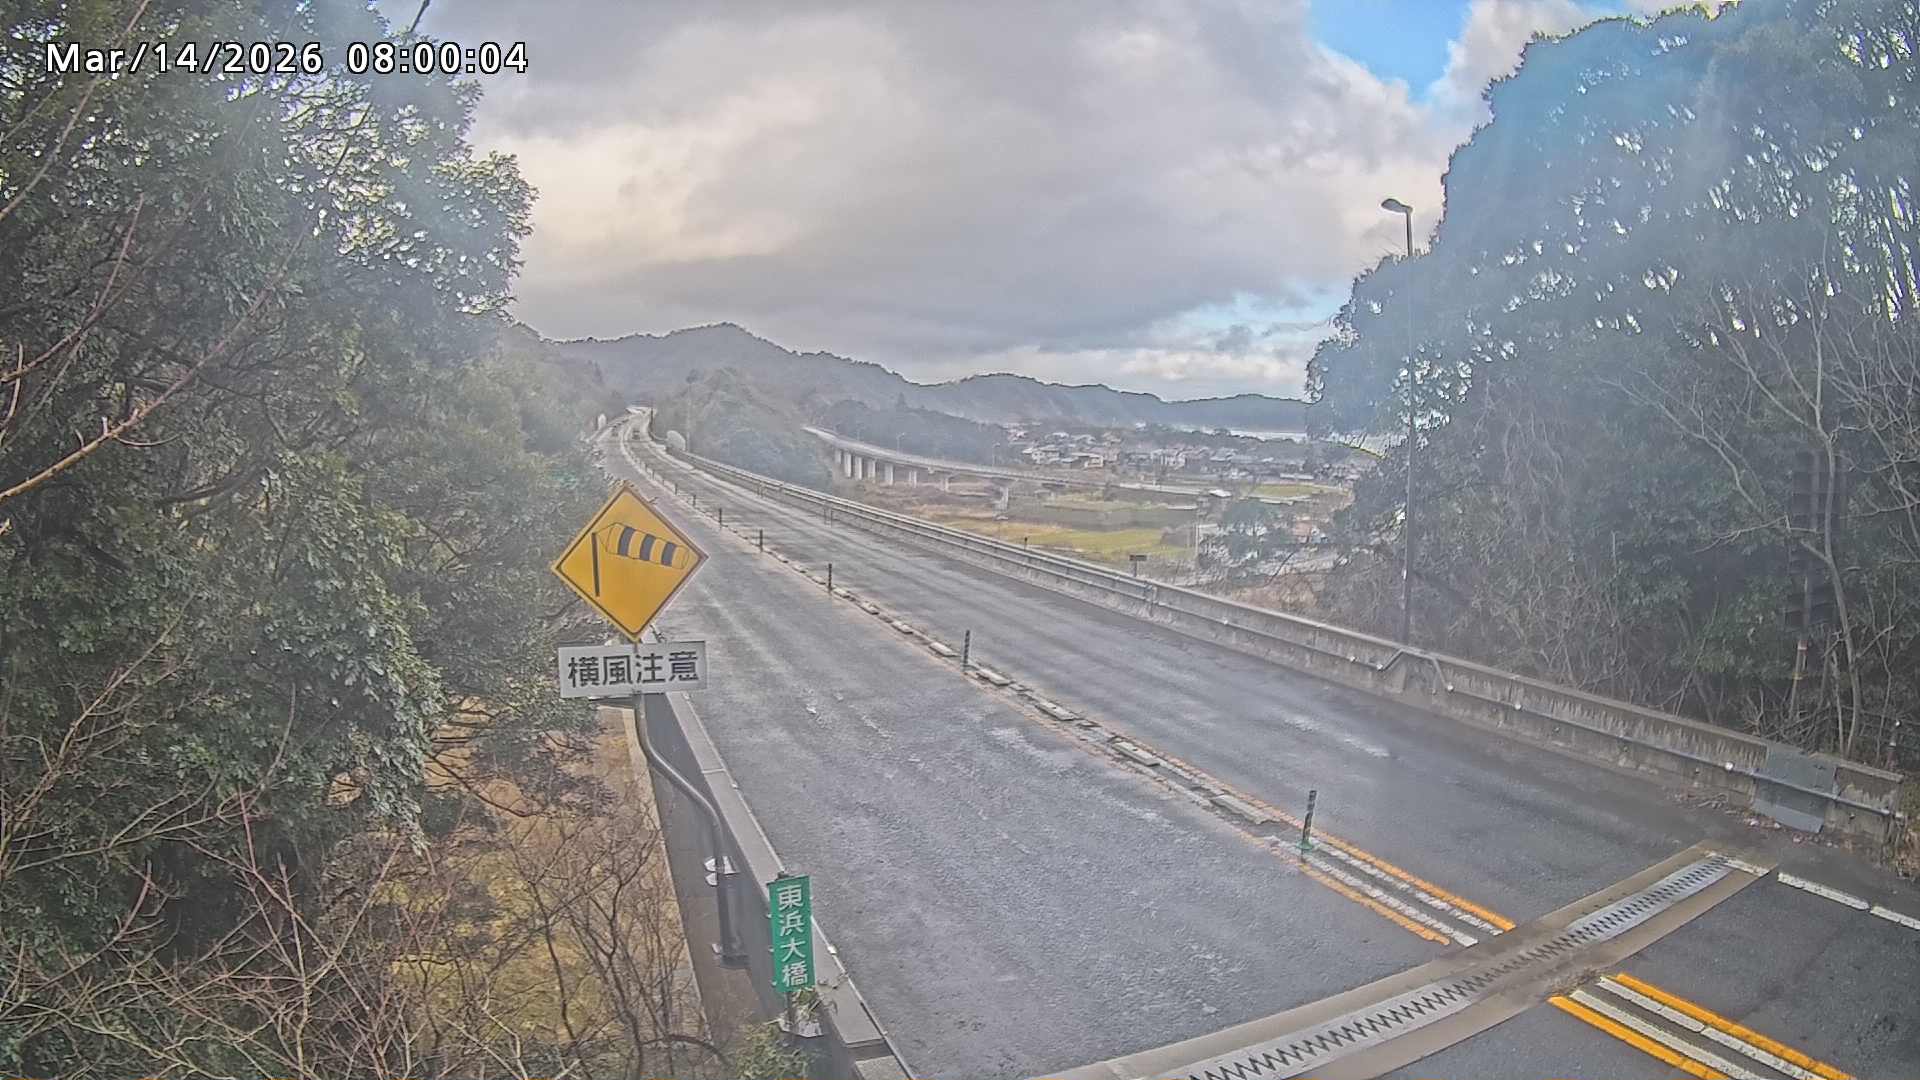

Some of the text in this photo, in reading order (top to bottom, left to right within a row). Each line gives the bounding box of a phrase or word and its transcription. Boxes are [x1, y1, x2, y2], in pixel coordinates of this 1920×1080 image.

[568, 651, 699, 688] 横風注意
[777, 884, 808, 988] 東浜大橋
